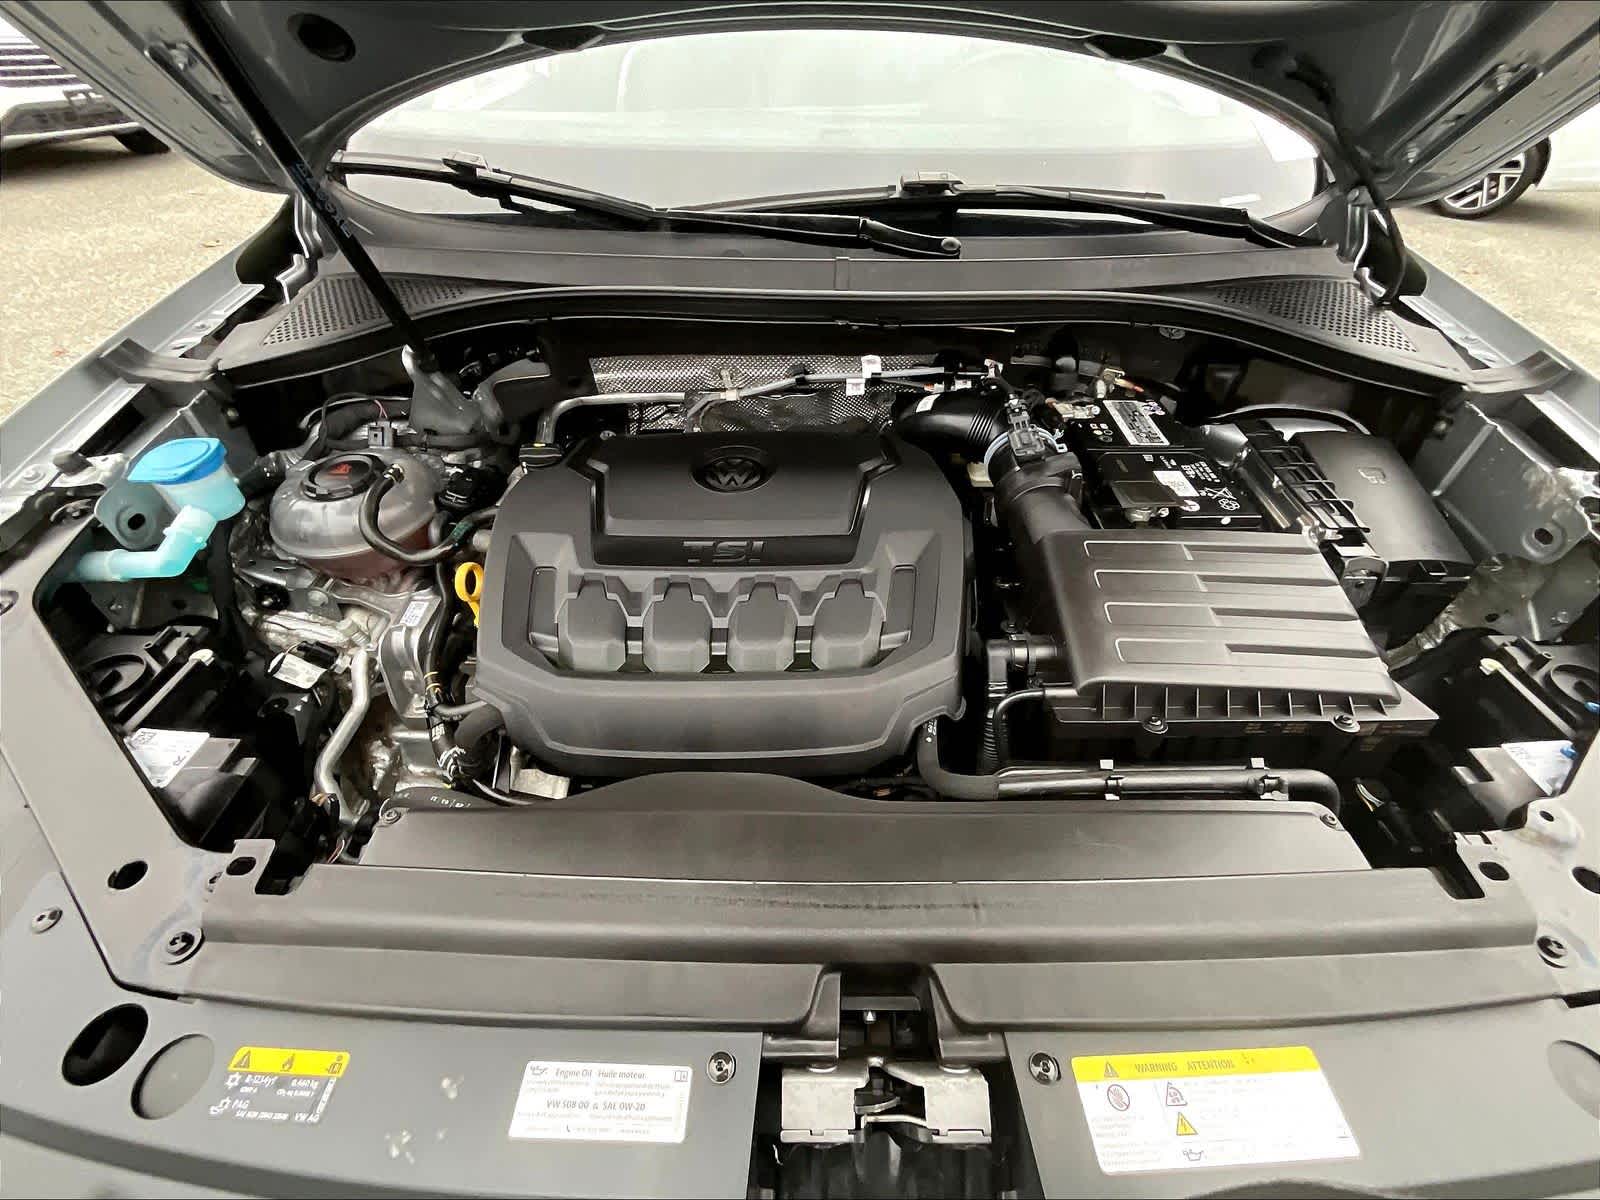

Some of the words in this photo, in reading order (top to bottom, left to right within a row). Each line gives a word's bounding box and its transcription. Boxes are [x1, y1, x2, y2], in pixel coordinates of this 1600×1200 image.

[683, 540, 764, 563] TSI
[1135, 1062, 1178, 1073] WARNING
[1187, 1059, 1234, 1071] ATTENTION
[555, 1068, 580, 1079] Engine
[581, 1069, 592, 1079] Oil
[598, 1069, 618, 1079] Huile
[547, 1100, 561, 1109] VW
[562, 1100, 577, 1109] 508
[578, 1101, 590, 1109] 00
